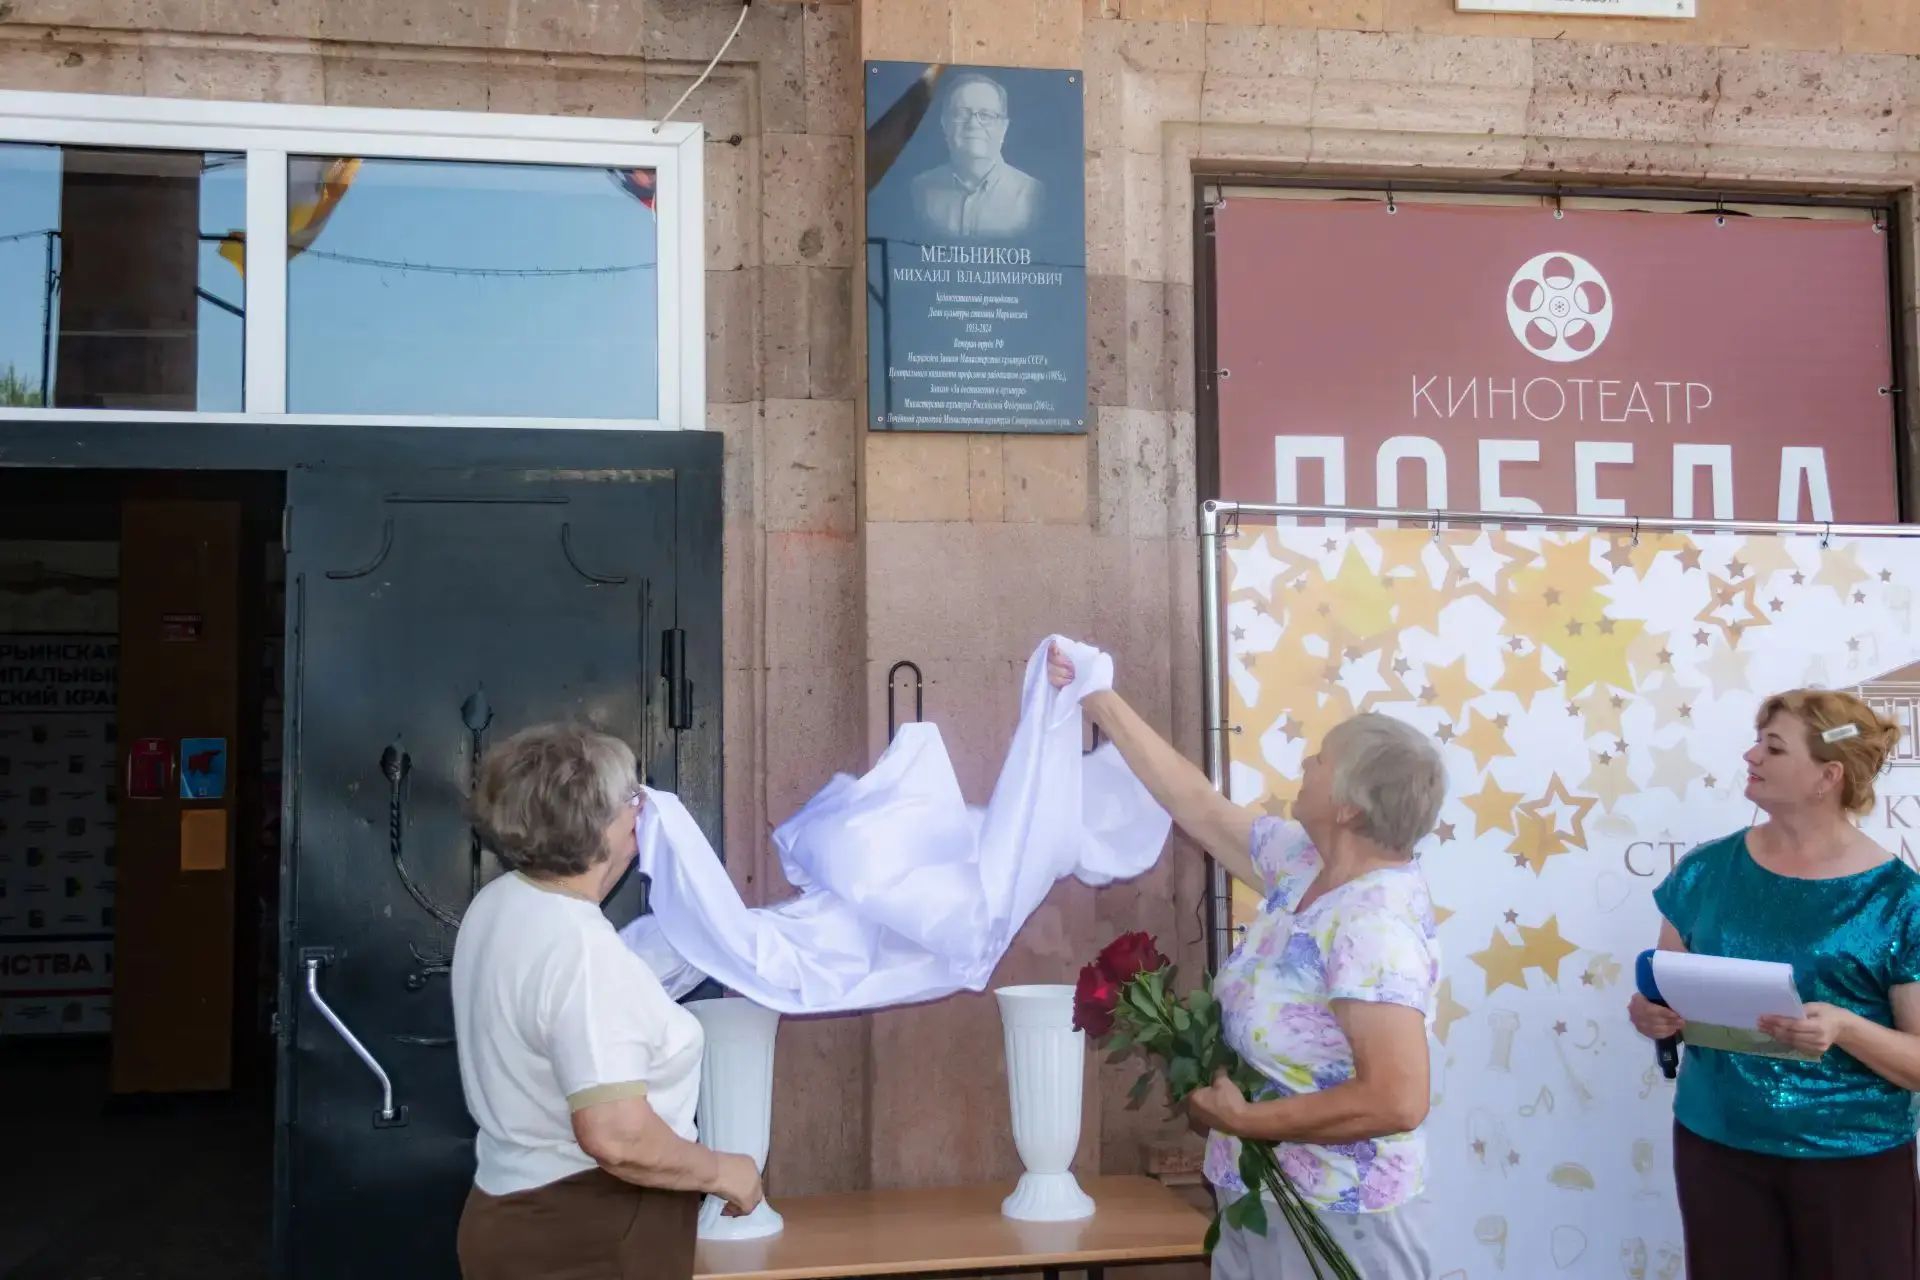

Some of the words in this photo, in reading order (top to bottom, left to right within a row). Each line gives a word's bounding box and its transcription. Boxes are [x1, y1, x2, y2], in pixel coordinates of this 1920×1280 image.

[921, 246, 1031, 265] МЕЛЬНИКОВ
[894, 269, 950, 282] МИХАИЛ
[957, 271, 1063, 285] ВЛАДИМИРОВИЧ
[1411, 375, 1713, 424] КИНОТЕАТР
